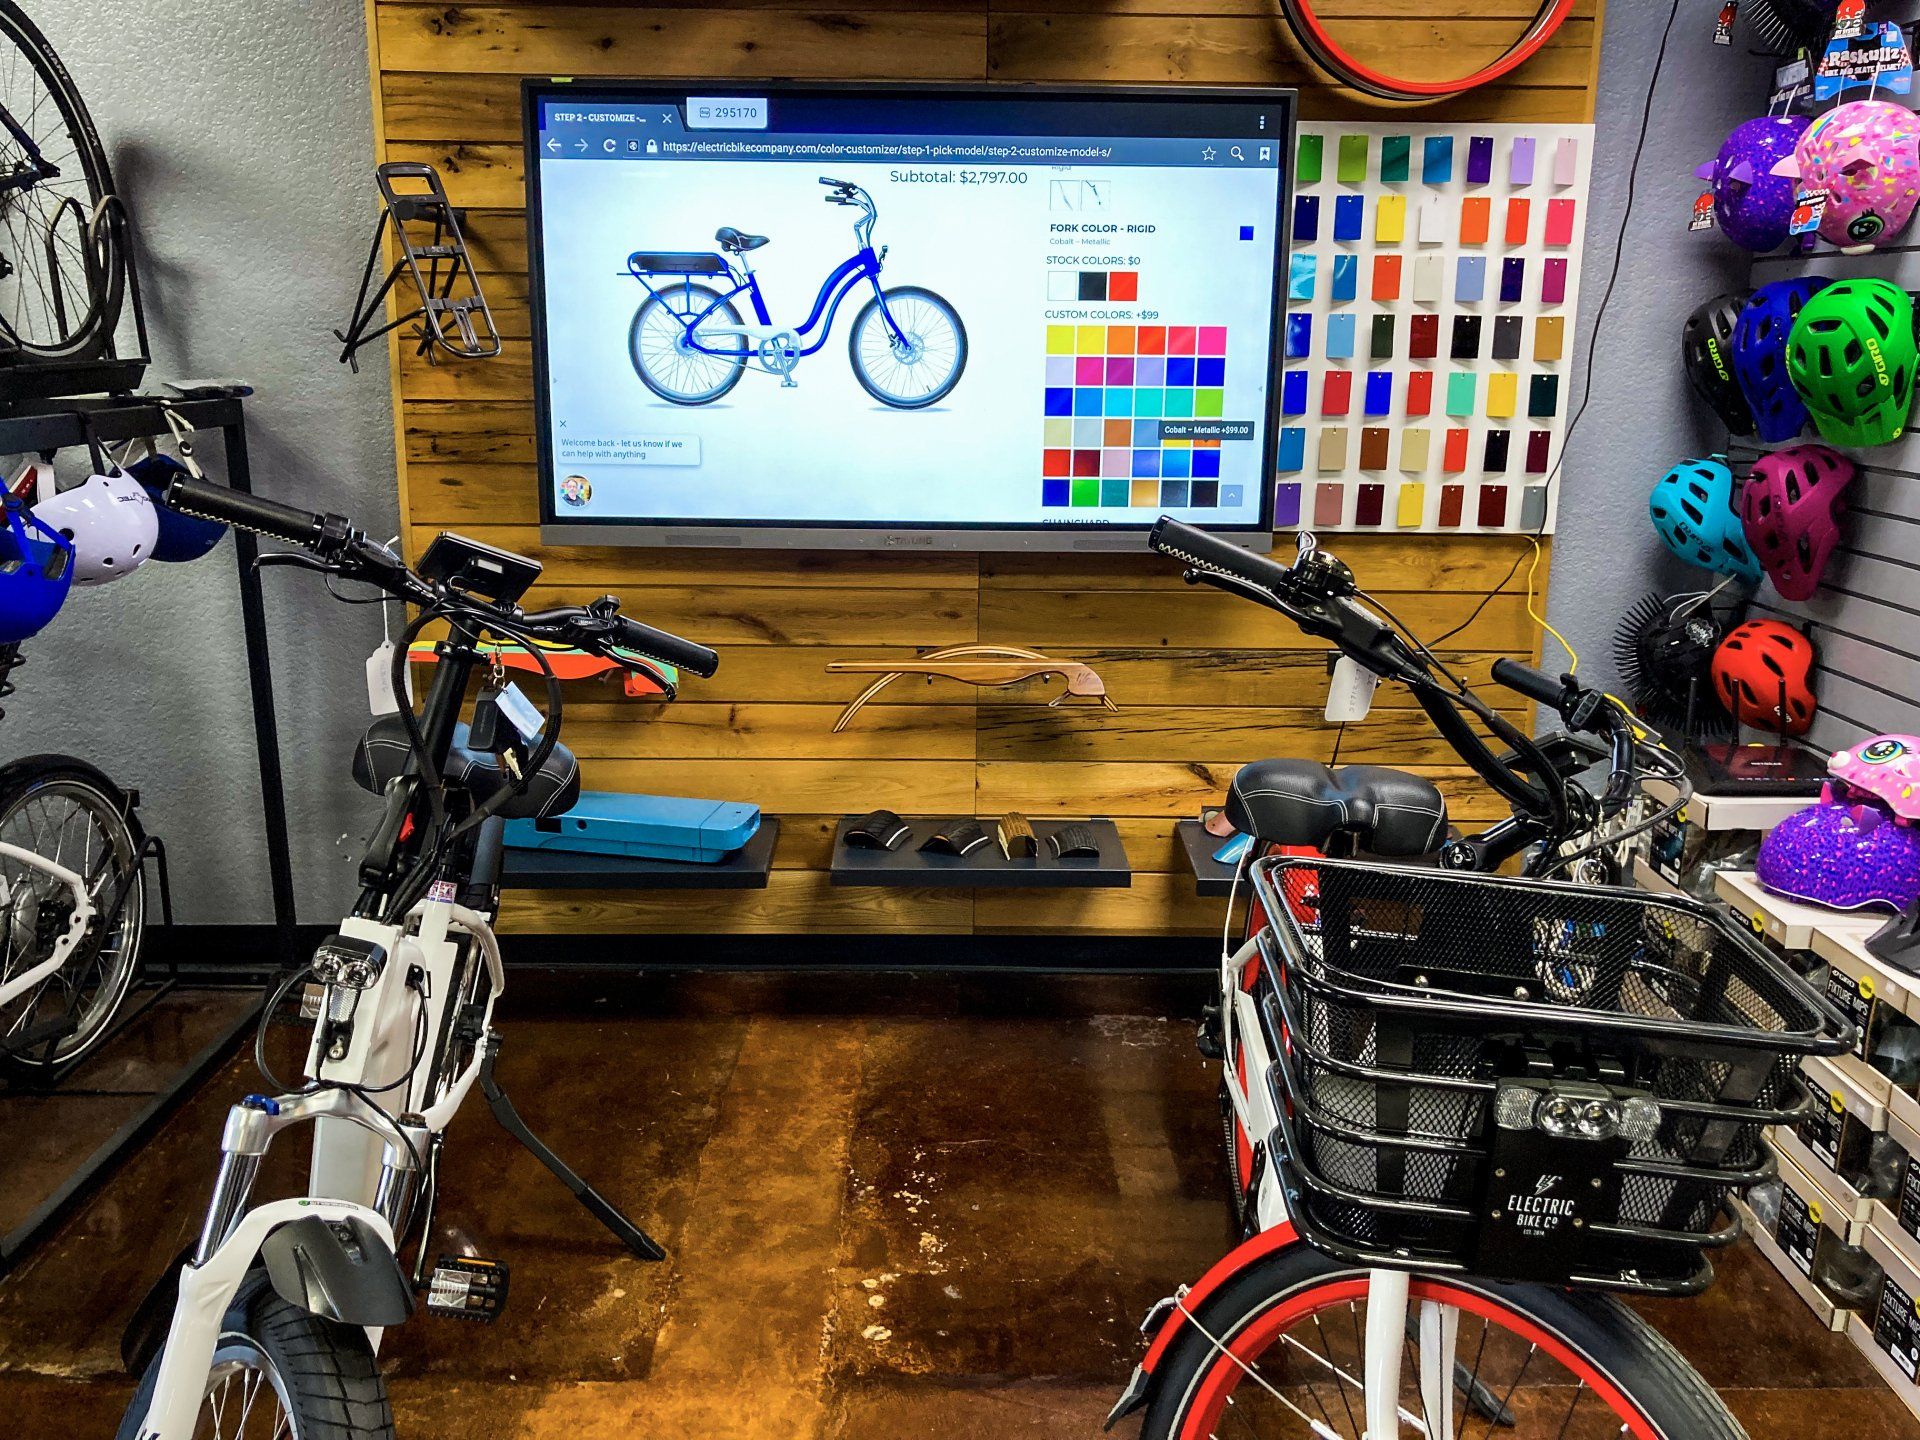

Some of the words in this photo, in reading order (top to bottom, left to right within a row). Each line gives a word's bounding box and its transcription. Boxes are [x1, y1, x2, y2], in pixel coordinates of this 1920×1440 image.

[42, 43, 69, 80] GIANT
[1829, 47, 1900, 66] Raskullz
[554, 113, 576, 122] STEP
[576, 113, 583, 122] 2
[588, 113, 635, 122] CUSTOMIZE
[715, 107, 757, 118] 295170
[890, 170, 956, 183] Subtotal:
[959, 171, 1028, 185] $2,797.00
[1050, 223, 1079, 233] FORK
[1081, 224, 1118, 233] COLOR
[1127, 224, 1156, 233] RIGID
[1046, 255, 1080, 265] STOCK
[1081, 256, 1126, 265] COLORS:
[1127, 255, 1141, 266] $0
[1044, 310, 1088, 319] CUSTOM
[1090, 310, 1134, 319] COLORS:
[1136, 309, 1159, 320] +$99
[1164, 425, 1187, 434] Cobalt
[1193, 425, 1220, 434] Metallic
[1221, 425, 1249, 435] +$99.00
[561, 438, 596, 447] Welcome
[597, 439, 616, 447] back
[621, 440, 631, 448] let
[643, 440, 664, 448] know
[577, 449, 594, 459] help
[595, 450, 612, 458] with
[613, 450, 646, 460] anything
[1507, 1194, 1575, 1216] ELECTRIC
[1516, 1213, 1542, 1228] BIKE
[1883, 1289, 1908, 1323] FIXTURE
